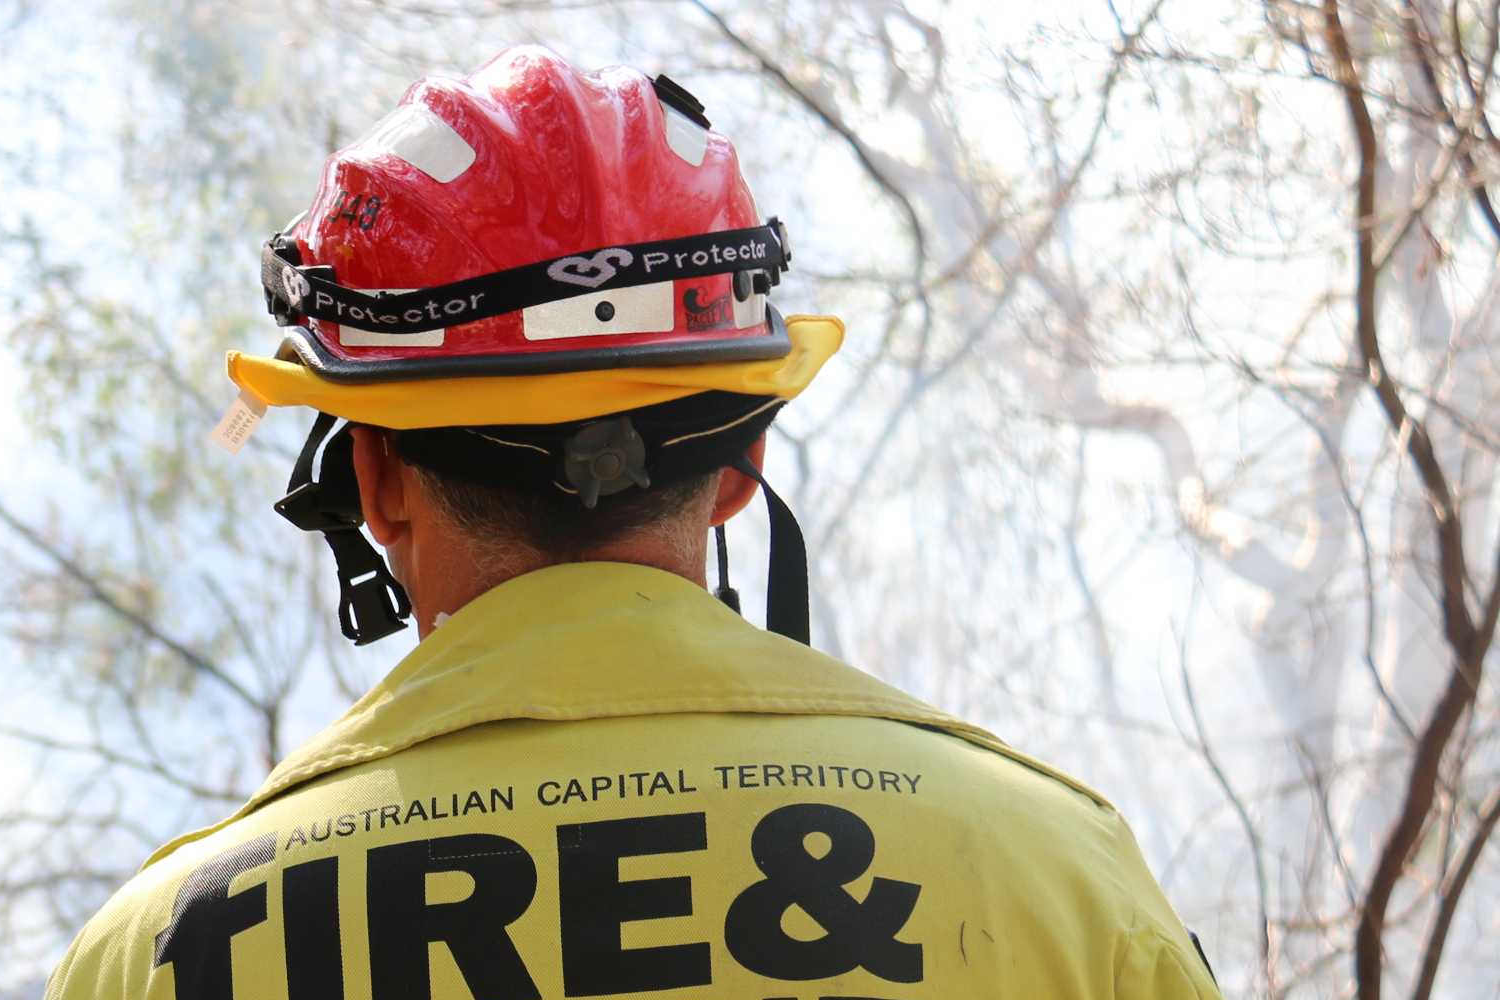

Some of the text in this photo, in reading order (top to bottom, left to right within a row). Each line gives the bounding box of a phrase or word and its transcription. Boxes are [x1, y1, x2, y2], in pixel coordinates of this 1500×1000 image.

[643, 239, 766, 273] Protector
[315, 290, 485, 324] Protector
[285, 764, 924, 851] AUSTRALIAN CAPITAL TERRITORY
